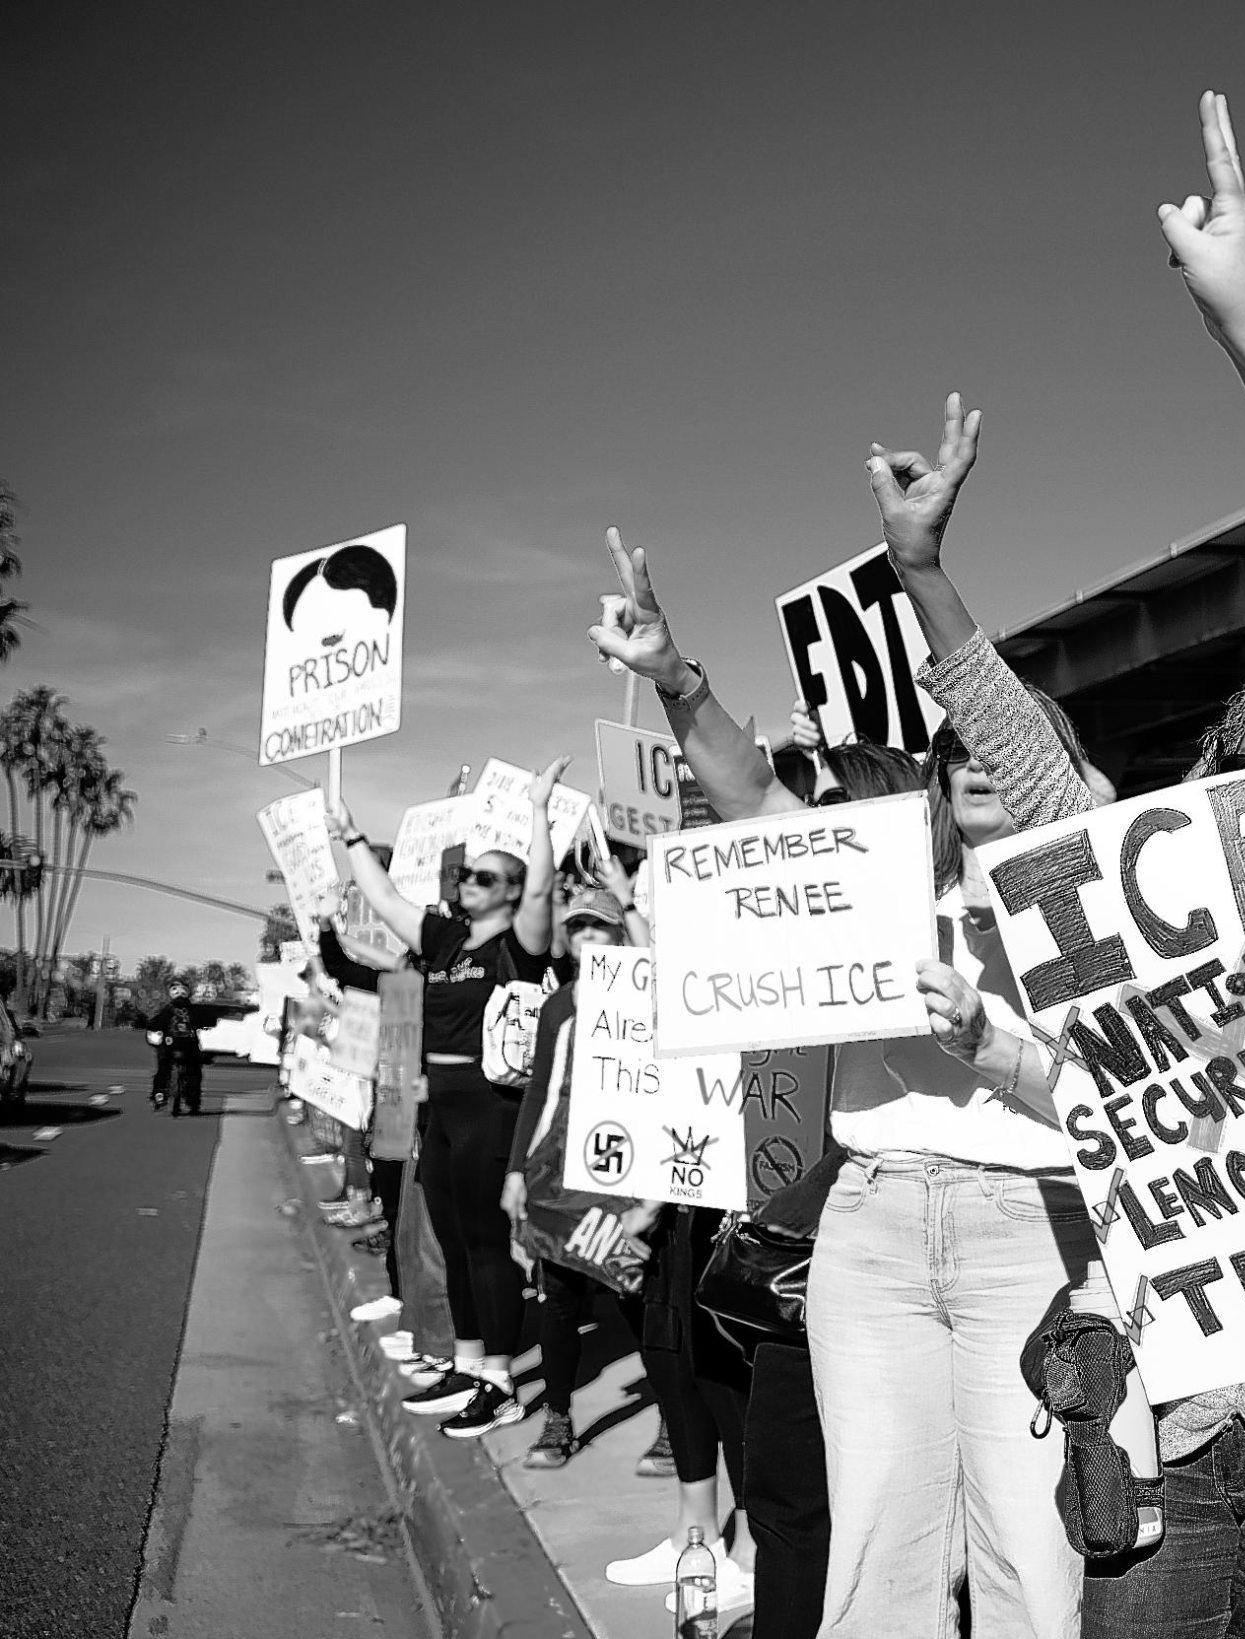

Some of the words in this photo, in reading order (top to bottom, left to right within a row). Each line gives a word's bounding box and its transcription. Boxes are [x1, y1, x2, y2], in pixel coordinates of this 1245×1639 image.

[288, 632, 391, 697] PRISON
[663, 828, 870, 884] REMEMBER
[724, 881, 854, 920] RENEE
[591, 954, 622, 992] My
[682, 966, 806, 1016] CRUSH
[816, 960, 906, 1007] ICE
[591, 1009, 654, 1043] Alre
[592, 1055, 660, 1094] This
[696, 1065, 802, 1124] WAR
[669, 1185, 703, 1199] KINGS
[671, 1165, 704, 1188] NO
